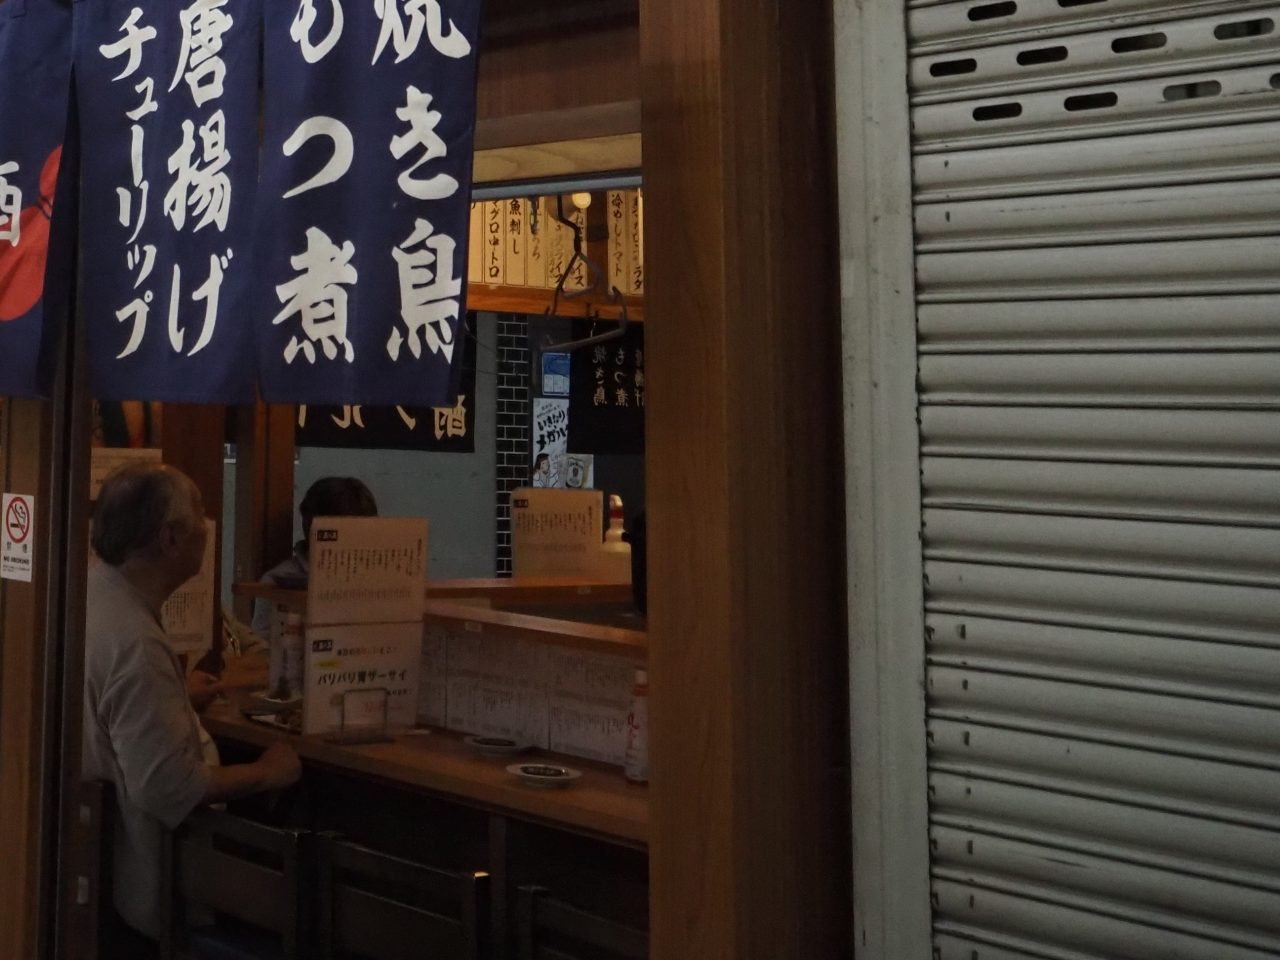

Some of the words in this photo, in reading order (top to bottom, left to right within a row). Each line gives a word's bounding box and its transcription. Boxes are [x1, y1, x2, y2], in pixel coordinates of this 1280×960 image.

[99, 7, 158, 359] チューリップ
